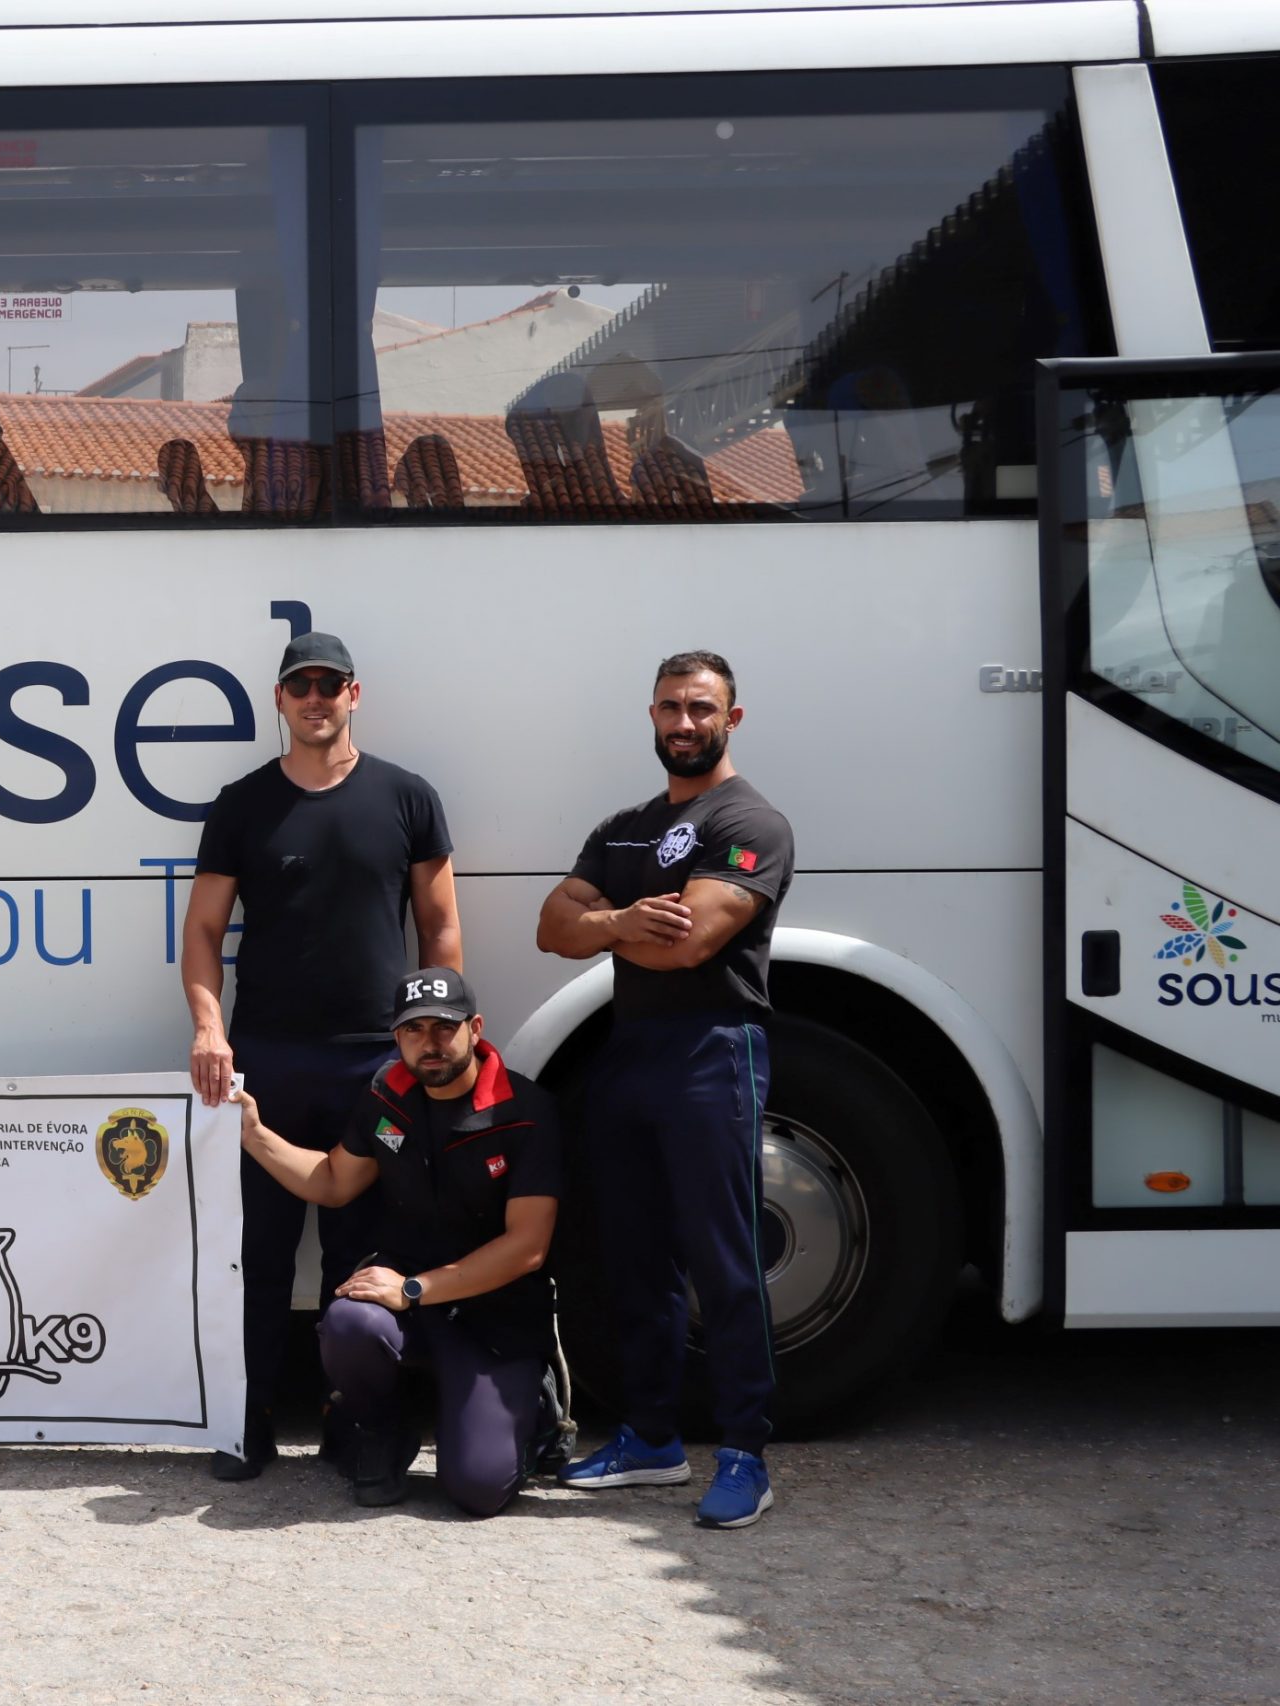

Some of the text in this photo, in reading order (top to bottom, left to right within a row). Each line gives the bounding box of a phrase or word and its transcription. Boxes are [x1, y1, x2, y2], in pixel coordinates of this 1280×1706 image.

[405, 979, 448, 1002] K-9
[27, 1123, 43, 1133] DE
[46, 1121, 88, 1135] ÉVORA
[0, 1139, 84, 1154] INTERVENÇÃO
[21, 1313, 107, 1364] K9
